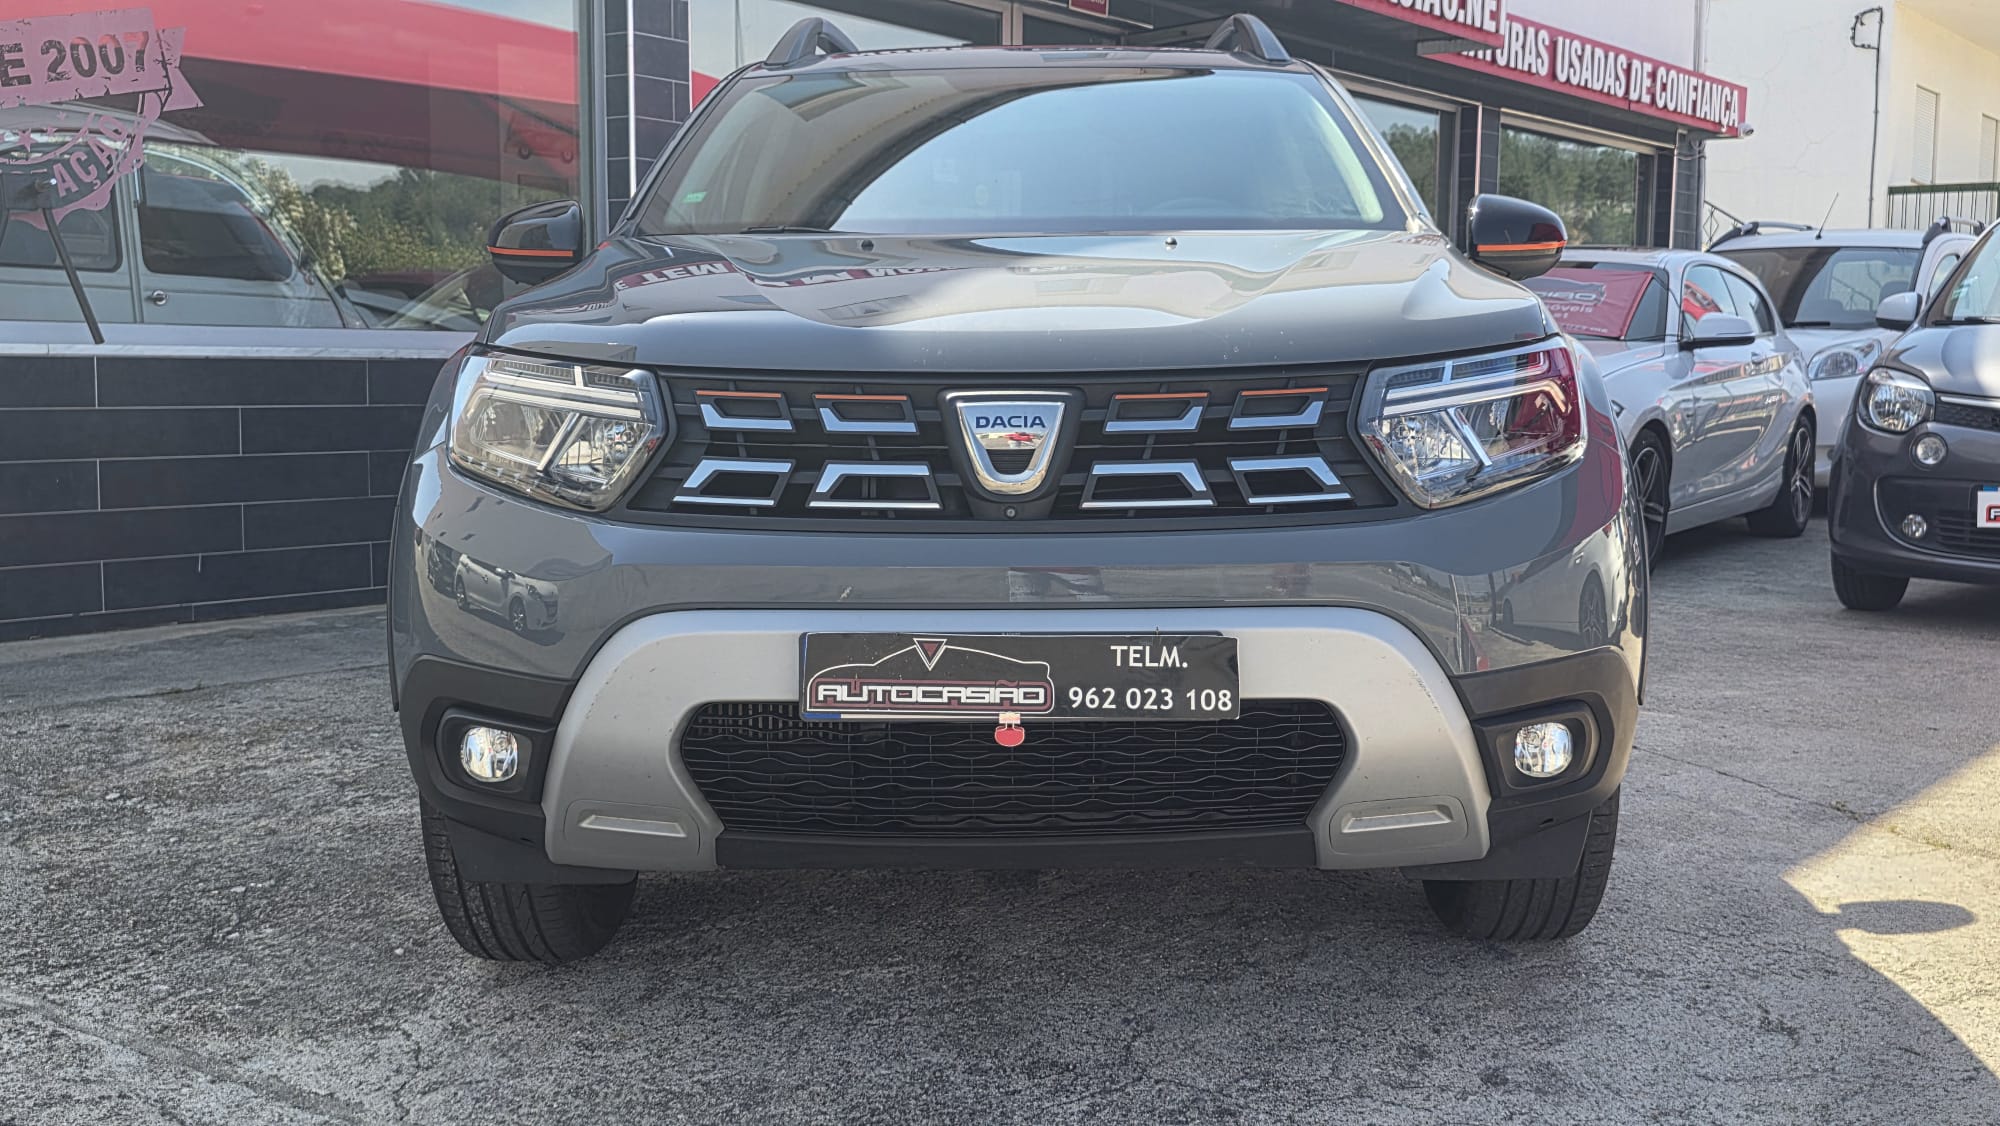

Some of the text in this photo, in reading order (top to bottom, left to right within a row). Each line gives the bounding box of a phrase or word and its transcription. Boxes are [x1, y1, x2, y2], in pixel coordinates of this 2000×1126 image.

[41, 31, 149, 83] 2007
[1555, 36, 1626, 98] USADAS
[1629, 59, 1652, 104] DE
[1655, 66, 1739, 132] CONFIANÇA
[975, 415, 1046, 429] DACIA
[1110, 645, 1188, 668] TELM.
[1068, 686, 1233, 711] 962 023 108
